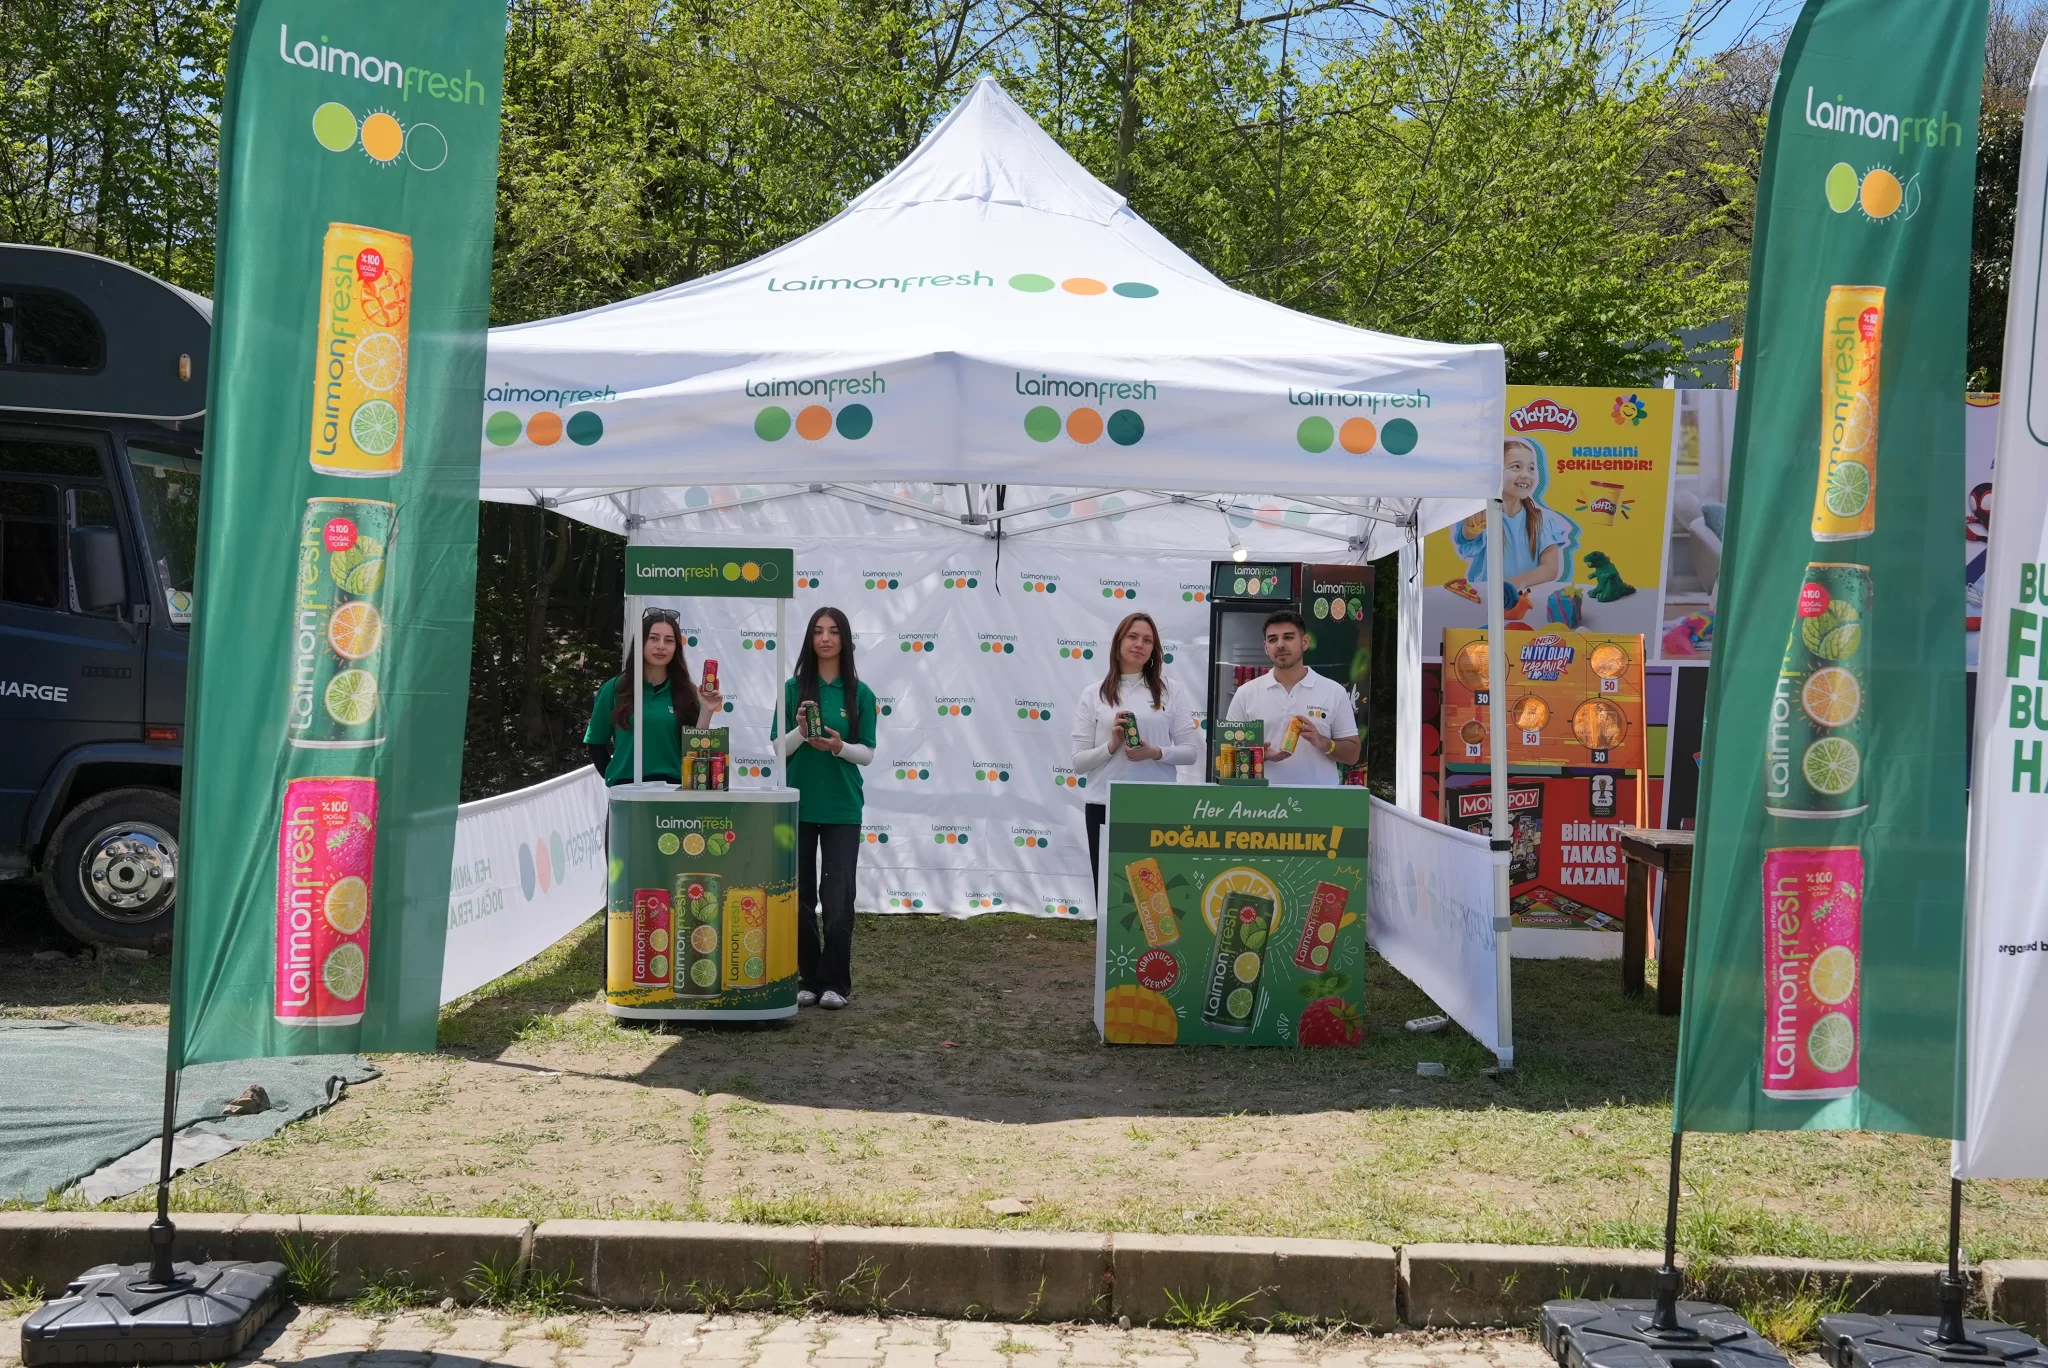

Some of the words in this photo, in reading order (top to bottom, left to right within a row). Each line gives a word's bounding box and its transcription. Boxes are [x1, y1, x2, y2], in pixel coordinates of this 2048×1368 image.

[280, 24, 485, 106] Laimonfresh
[768, 270, 994, 293] Laimonfresh
[316, 254, 355, 456] Laimonfresh
[746, 371, 886, 402] Laimonfresh
[1015, 372, 1157, 406] Laimonfresh
[1289, 387, 1431, 415] Laimonfresh
[1510, 402, 1577, 429] Play-Doh
[329, 525, 348, 534] %100
[636, 562, 719, 582] Laimonfresh
[1233, 565, 1277, 577] Laimonfresh
[1312, 580, 1366, 598] Laimonfresh
[290, 526, 328, 731] Laimonfresh
[1520, 646, 1533, 660] EN
[1533, 644, 1548, 660] İYİ
[1547, 647, 1571, 661] OLAN
[1522, 658, 1568, 673] KAZANIR!
[1603, 681, 1615, 690] 50
[1477, 693, 1489, 703] 30
[683, 726, 728, 737] Laimonfresh
[1216, 719, 1263, 731] Laimonfresh
[1525, 733, 1537, 743] 50
[1468, 746, 1478, 755] 70
[1594, 752, 1606, 762] 30
[322, 801, 349, 812] %100
[1193, 799, 1224, 820] Her
[1228, 801, 1289, 820] Anında
[655, 815, 733, 833] Laimonfresh
[1150, 825, 1220, 849] DOĞAL
[1560, 845, 1617, 864] TAKAS
[1560, 867, 1625, 886] KAZAN.
[1805, 872, 1832, 883] %100
[282, 806, 324, 1008] Laimonfresh
[674, 886, 690, 989] Laimonfresh
[1295, 892, 1325, 963] Laimonfresh
[635, 899, 650, 979] Laimonfresh
[729, 900, 743, 981] Laimonfresh
[1138, 951, 1174, 973] KORUYUCU
[1204, 907, 1239, 1017] Laimonfresh
[1142, 971, 1175, 989] İÇERMEZ
[1769, 876, 1809, 1081] Laimonfresh
